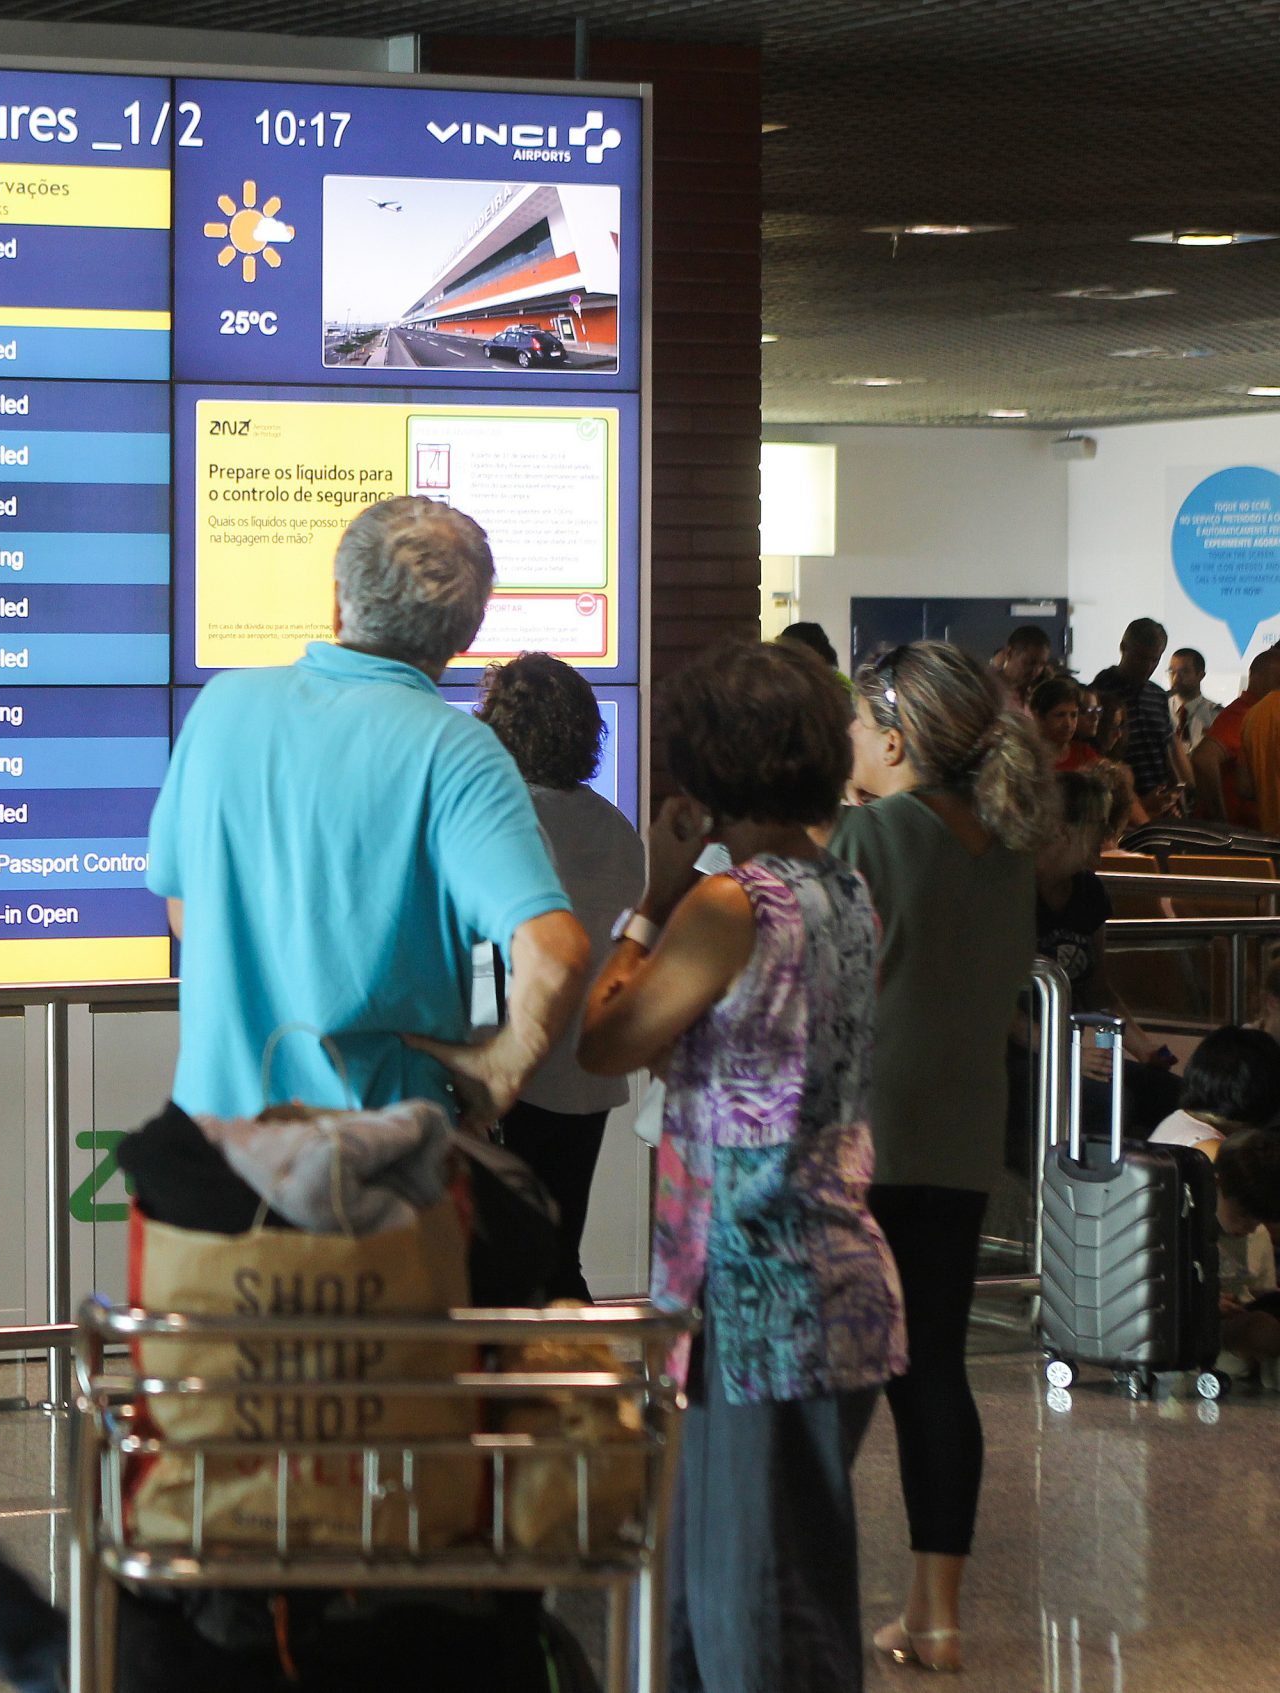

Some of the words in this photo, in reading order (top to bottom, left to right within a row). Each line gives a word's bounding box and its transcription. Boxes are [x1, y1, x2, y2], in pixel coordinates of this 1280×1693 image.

[255, 108, 351, 148] 10:17
[426, 121, 558, 150] VINCI
[512, 148, 572, 163] AIRPORTS
[209, 463, 271, 483] Prepare
[274, 468, 292, 480] os
[296, 463, 355, 485] líquidos
[359, 469, 393, 486] para
[208, 488, 219, 501] o
[222, 485, 290, 502] controlo
[293, 486, 313, 502] de
[208, 515, 236, 529] Quais
[237, 518, 249, 528] os
[250, 515, 287, 529] líquidos
[289, 518, 308, 530] que
[309, 519, 339, 531] posso
[209, 534, 222, 544] na
[223, 532, 271, 547] bagagem
[272, 532, 284, 544] de
[285, 532, 315, 545] mão?
[83, 850, 151, 876] Control
[26, 904, 79, 928] Open
[233, 1267, 386, 1317] SHOP
[233, 1392, 386, 1443] SHOP
